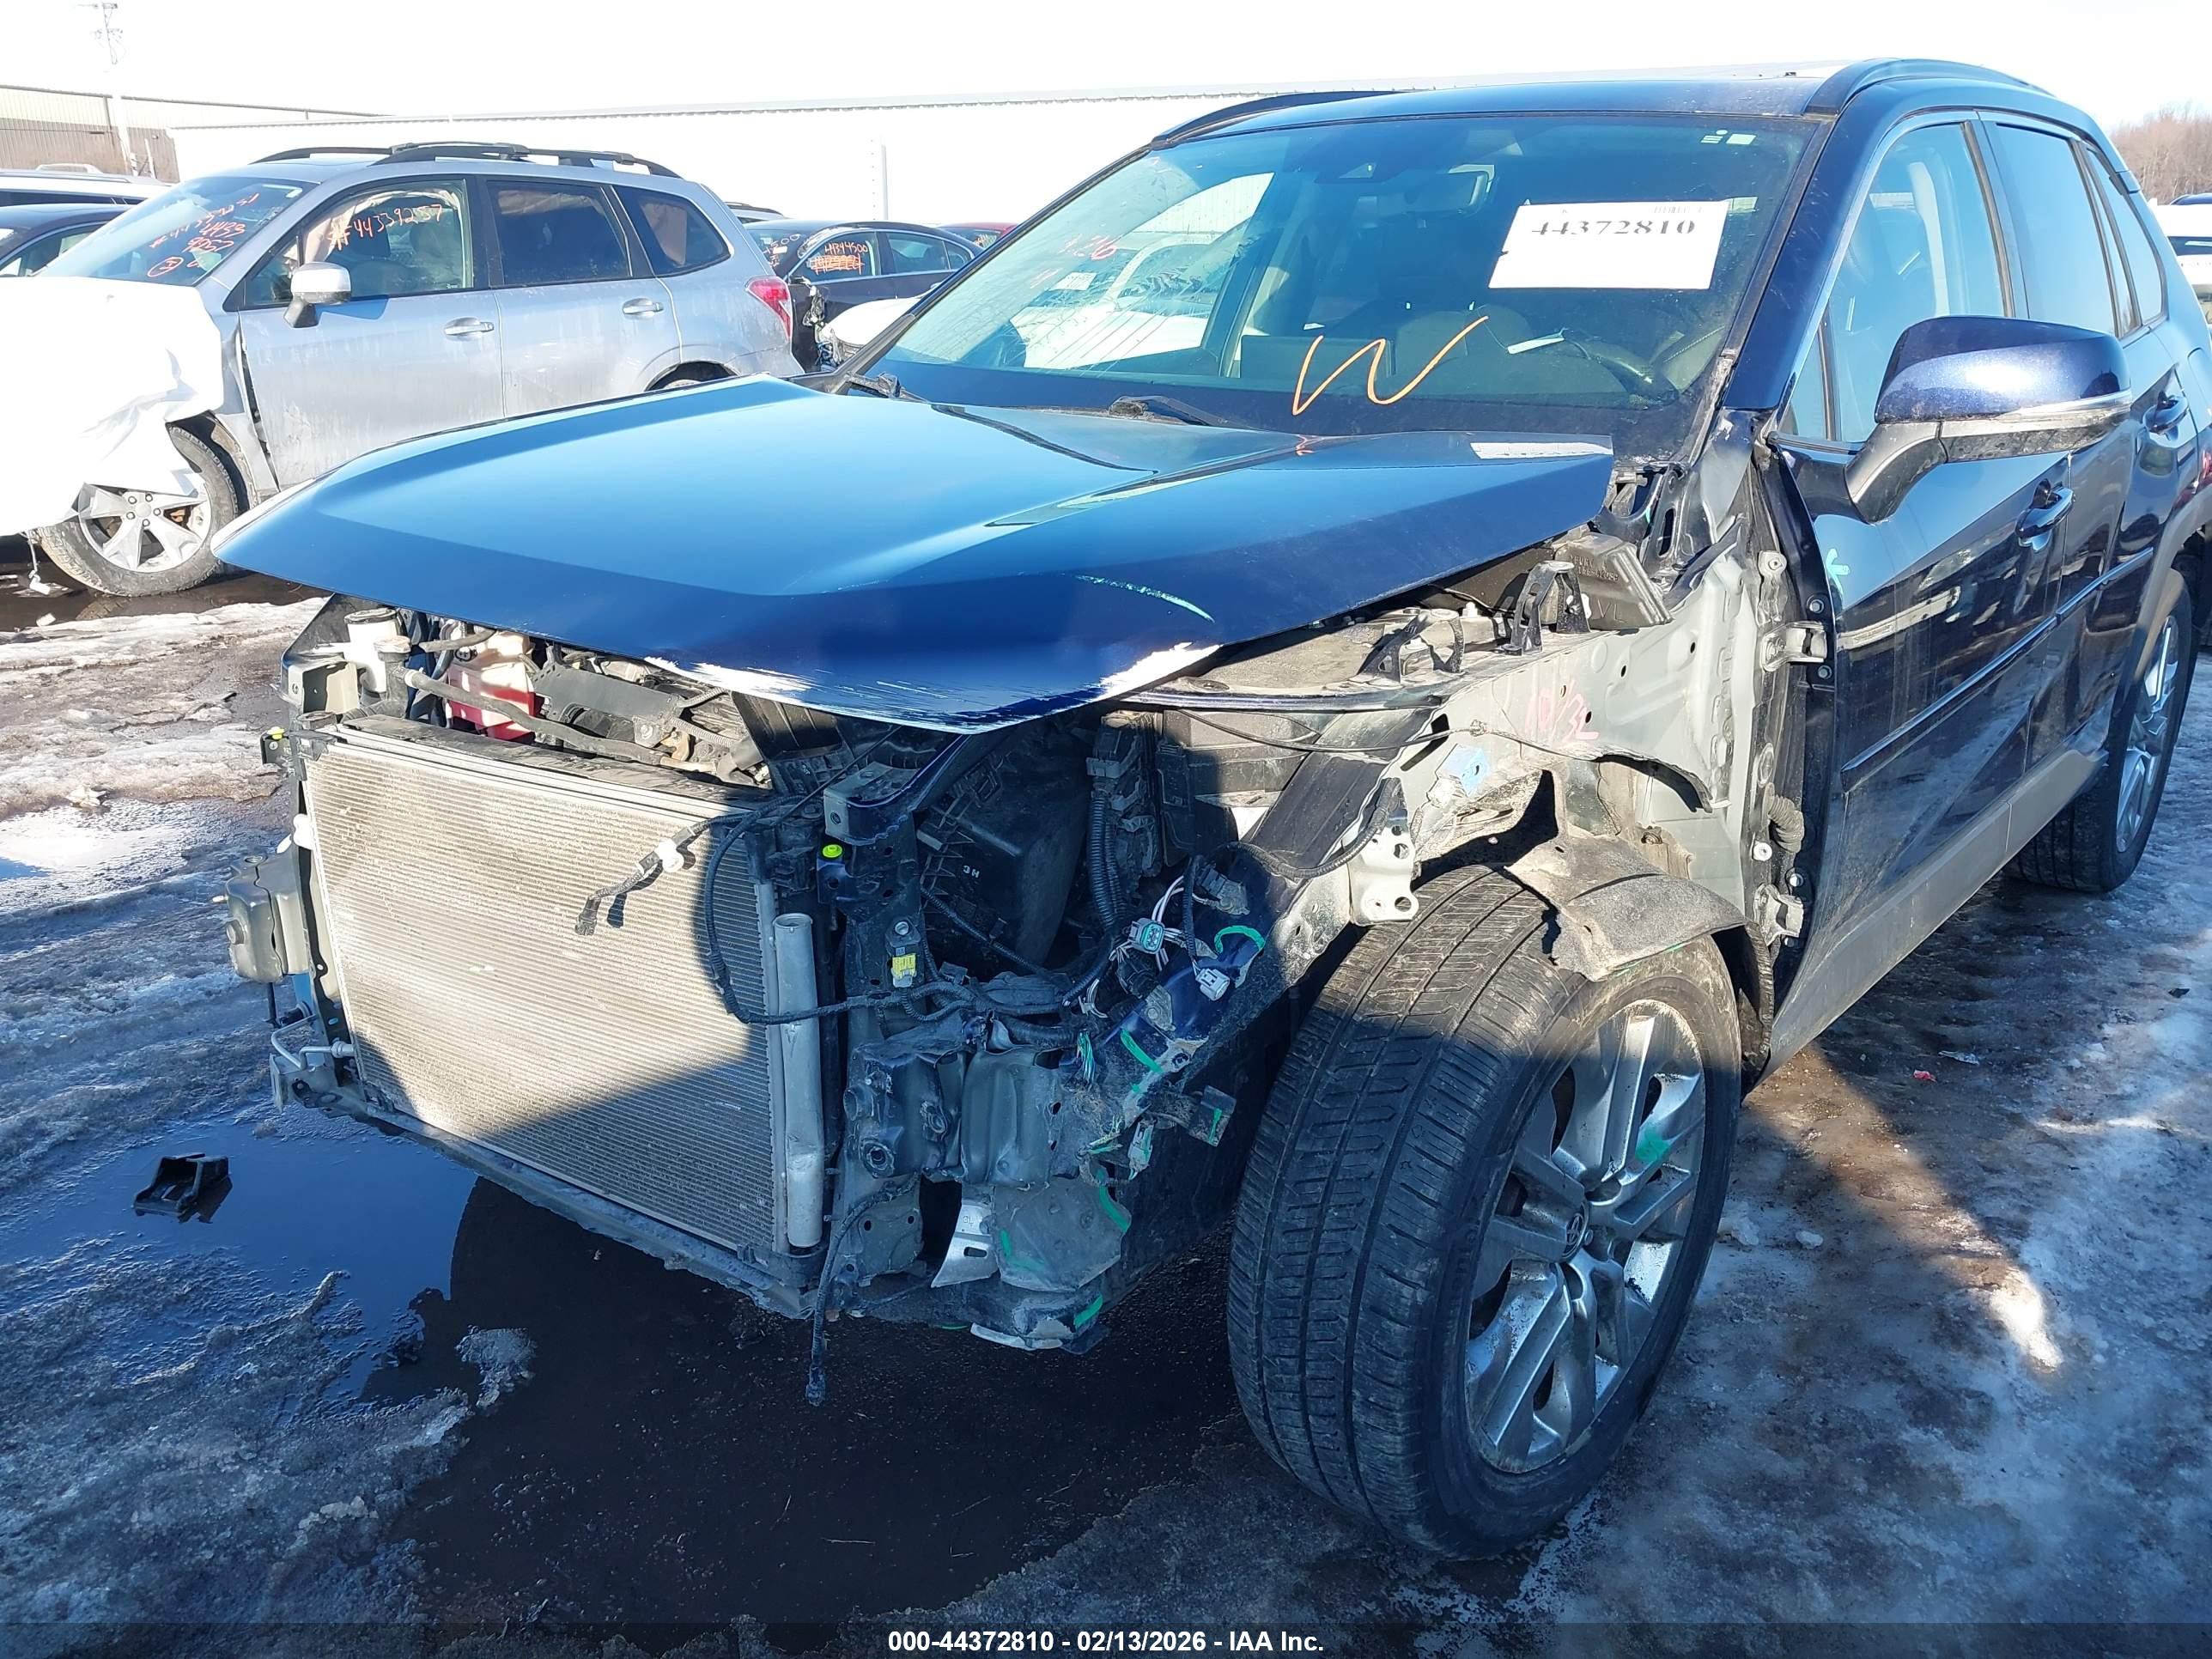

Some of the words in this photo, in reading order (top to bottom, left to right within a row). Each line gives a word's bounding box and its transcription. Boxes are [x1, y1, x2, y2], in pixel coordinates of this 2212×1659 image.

[326, 204, 442, 251] #44339257
[1532, 221, 1695, 235] 44372810
[1291, 315, 1489, 416] W
